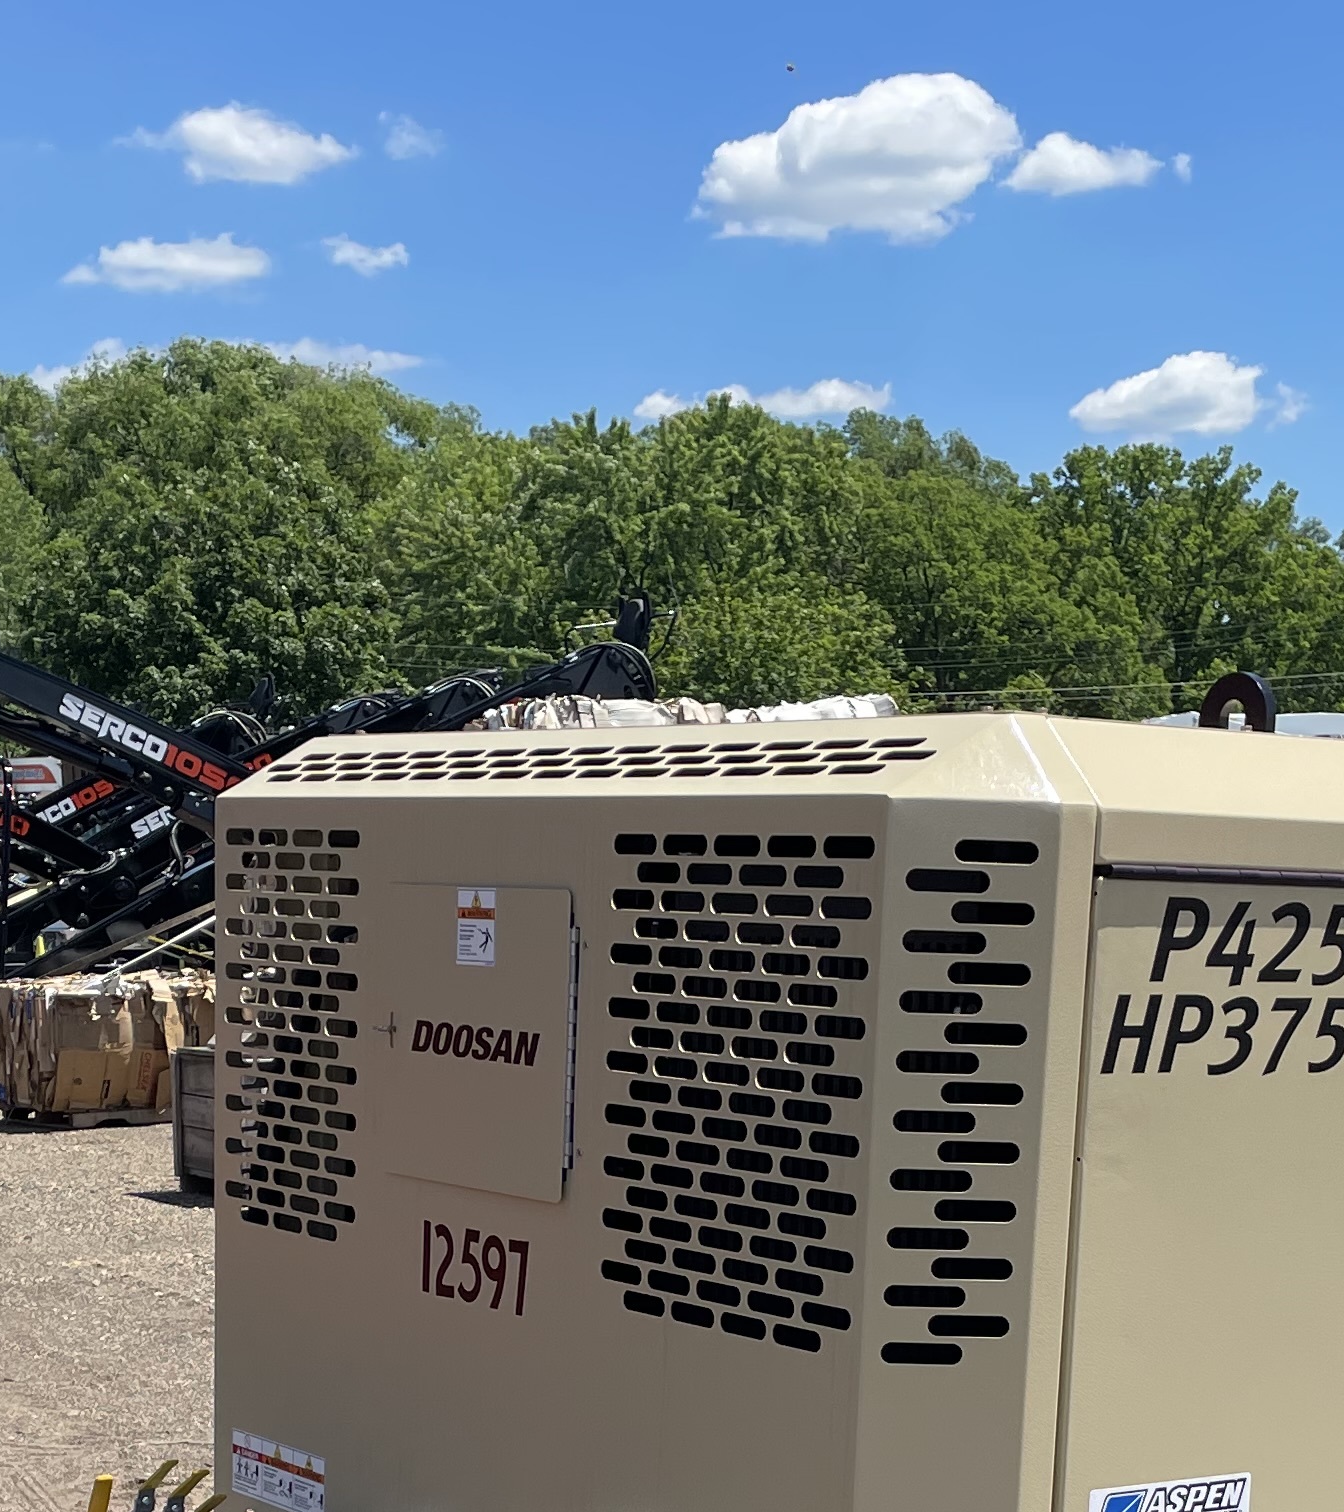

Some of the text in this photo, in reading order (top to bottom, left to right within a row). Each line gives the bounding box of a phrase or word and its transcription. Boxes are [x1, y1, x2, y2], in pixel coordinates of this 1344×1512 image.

[59, 692, 242, 792] SERCO105
[411, 1019, 540, 1067] DOOSAN
[422, 1219, 529, 1317] 12597
